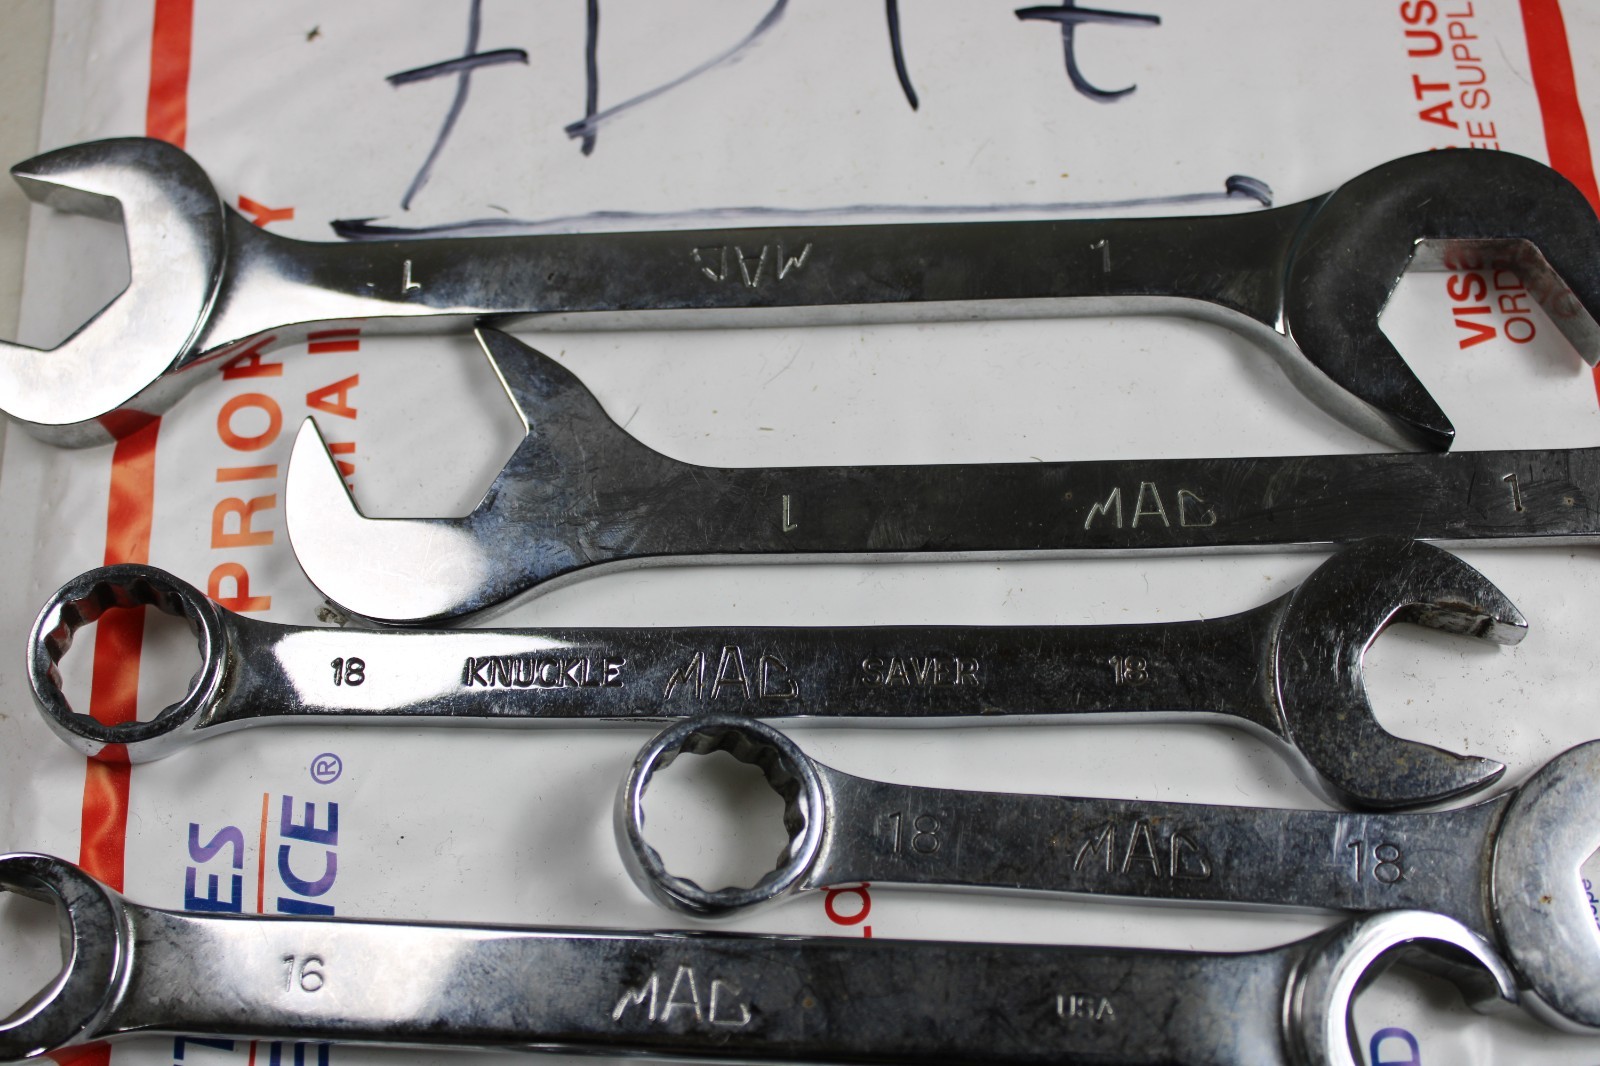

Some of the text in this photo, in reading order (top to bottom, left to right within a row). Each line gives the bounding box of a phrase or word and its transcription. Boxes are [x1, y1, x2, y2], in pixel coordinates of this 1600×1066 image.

[1412, 73, 1459, 130] AT
[331, 656, 366, 686] 18
[465, 656, 626, 689] KNUCKLE
[861, 656, 979, 686] SAVER
[1108, 655, 1149, 686] 18
[888, 811, 942, 854] 18
[1348, 839, 1402, 884] 18
[282, 953, 326, 993] 16
[1055, 993, 1115, 1021] USA
